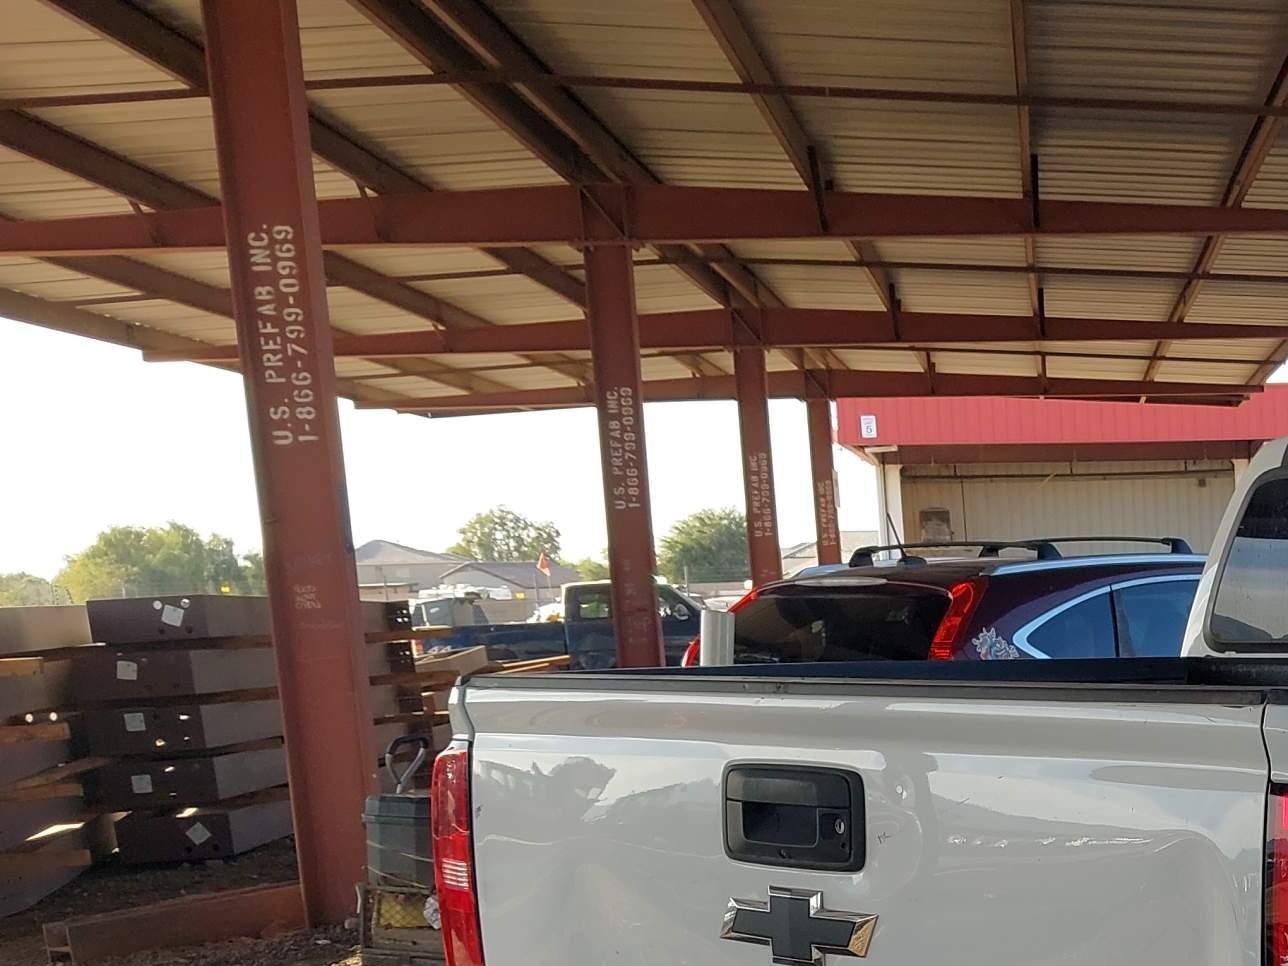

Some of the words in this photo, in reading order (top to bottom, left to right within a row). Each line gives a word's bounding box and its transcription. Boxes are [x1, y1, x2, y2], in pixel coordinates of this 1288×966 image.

[247, 224, 273, 272] INC.
[254, 285, 287, 383] PREFAB
[272, 225, 319, 442] 1-866-799-0969
[269, 398, 294, 445] U.S.
[606, 386, 619, 414] INC.
[608, 420, 624, 475] PREFAB
[613, 482, 626, 510] U.S.
